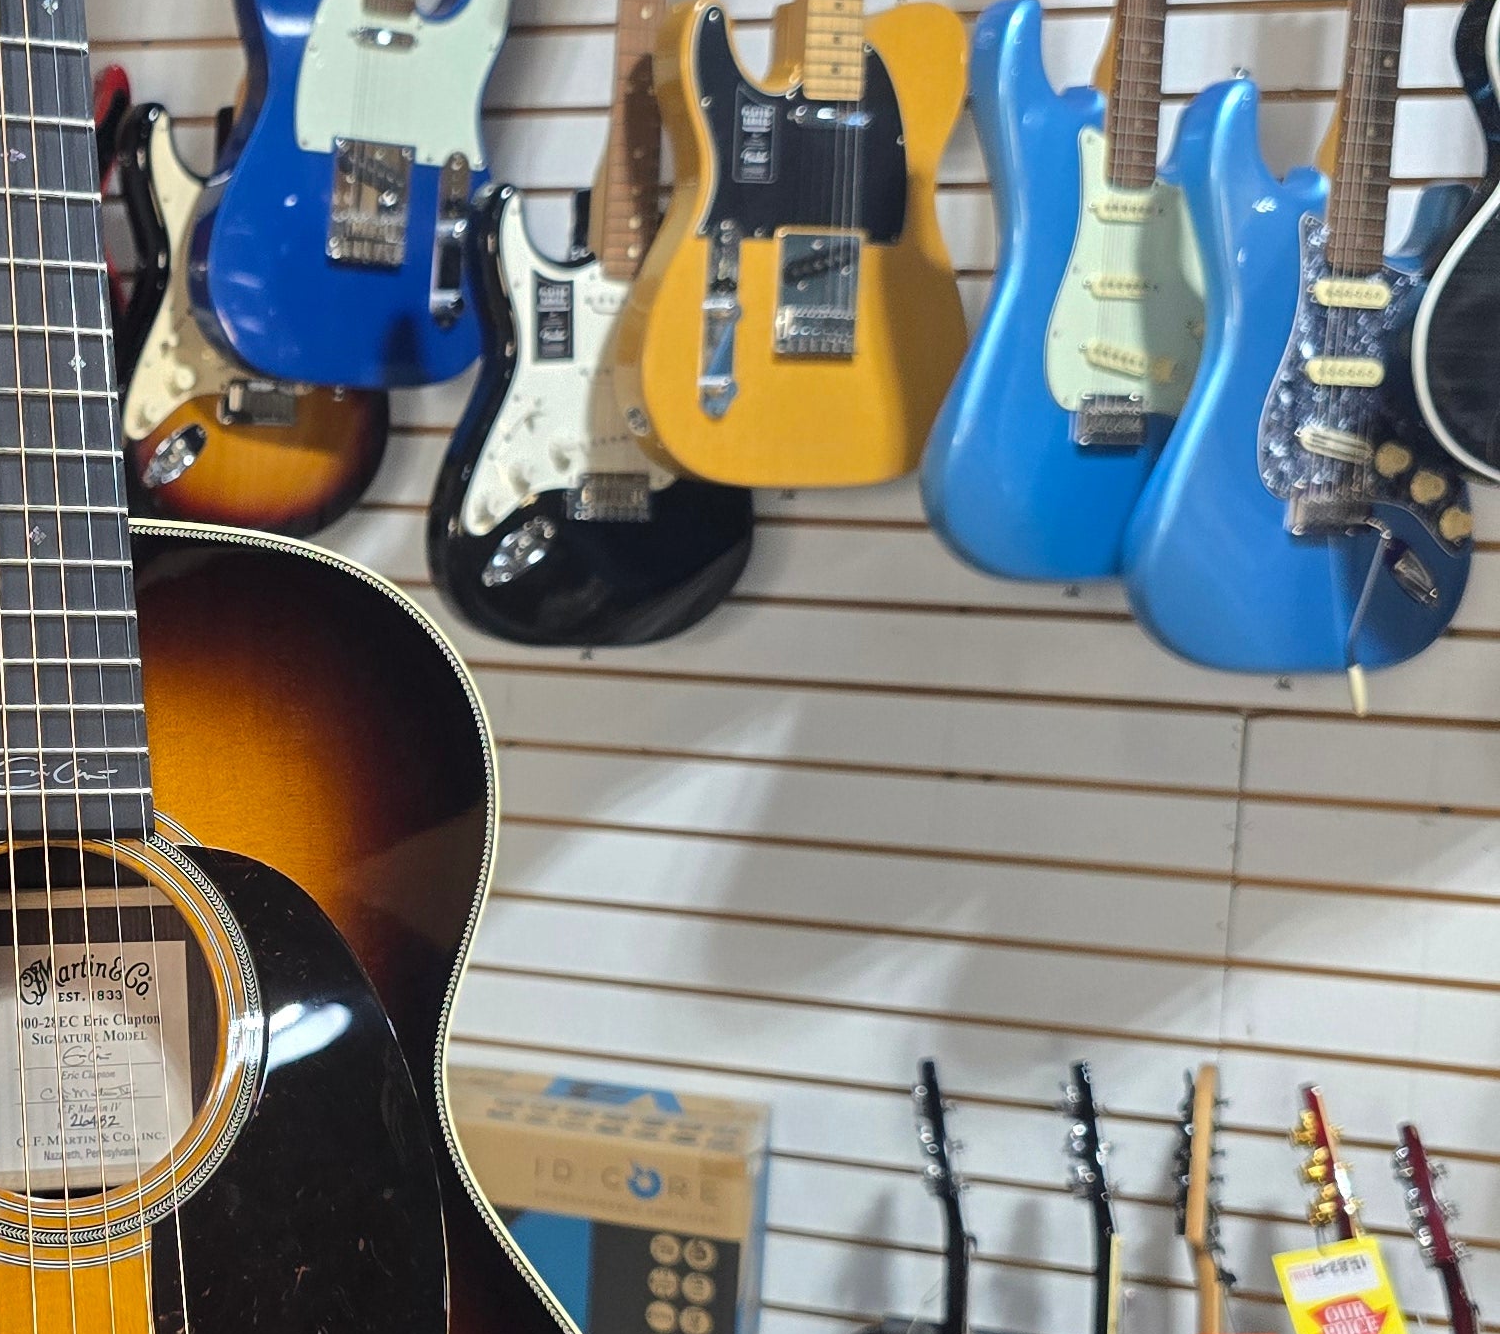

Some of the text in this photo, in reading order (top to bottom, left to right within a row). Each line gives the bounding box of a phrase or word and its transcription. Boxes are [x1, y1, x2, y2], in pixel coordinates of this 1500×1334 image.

[58, 989, 123, 1003] EST. 1833
[84, 1015, 109, 1027] Eric
[1323, 1299, 1368, 1324] OUR
